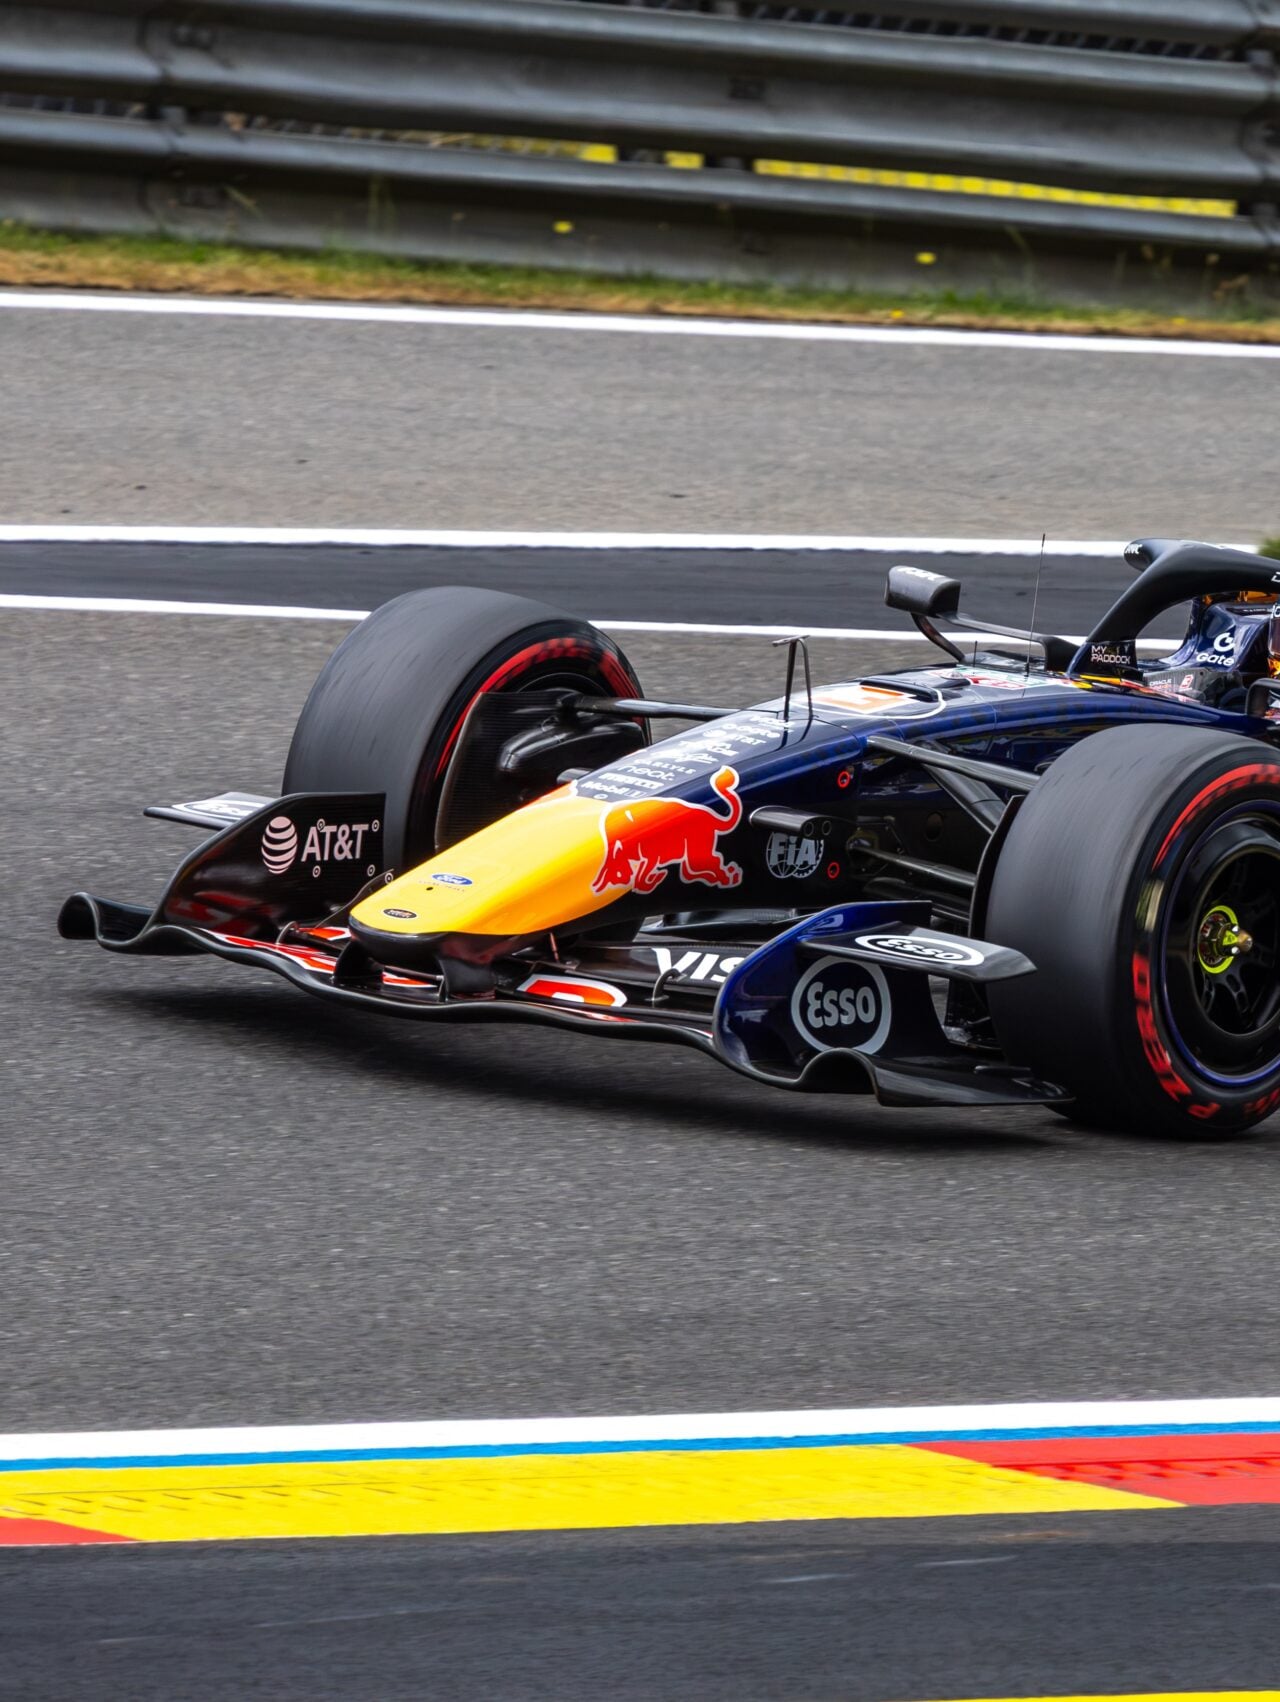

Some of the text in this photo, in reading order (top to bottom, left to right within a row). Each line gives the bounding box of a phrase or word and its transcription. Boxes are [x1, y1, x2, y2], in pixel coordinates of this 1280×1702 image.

[1091, 645, 1107, 654] MY
[1091, 654, 1131, 665] PADDOCK
[1196, 651, 1235, 667] Gate
[617, 765, 674, 781] neat.
[581, 781, 628, 795] Mobil
[301, 823, 369, 863] AT&T
[877, 938, 963, 960] Esso
[651, 947, 745, 983] VIS
[806, 981, 876, 1029] Esso
